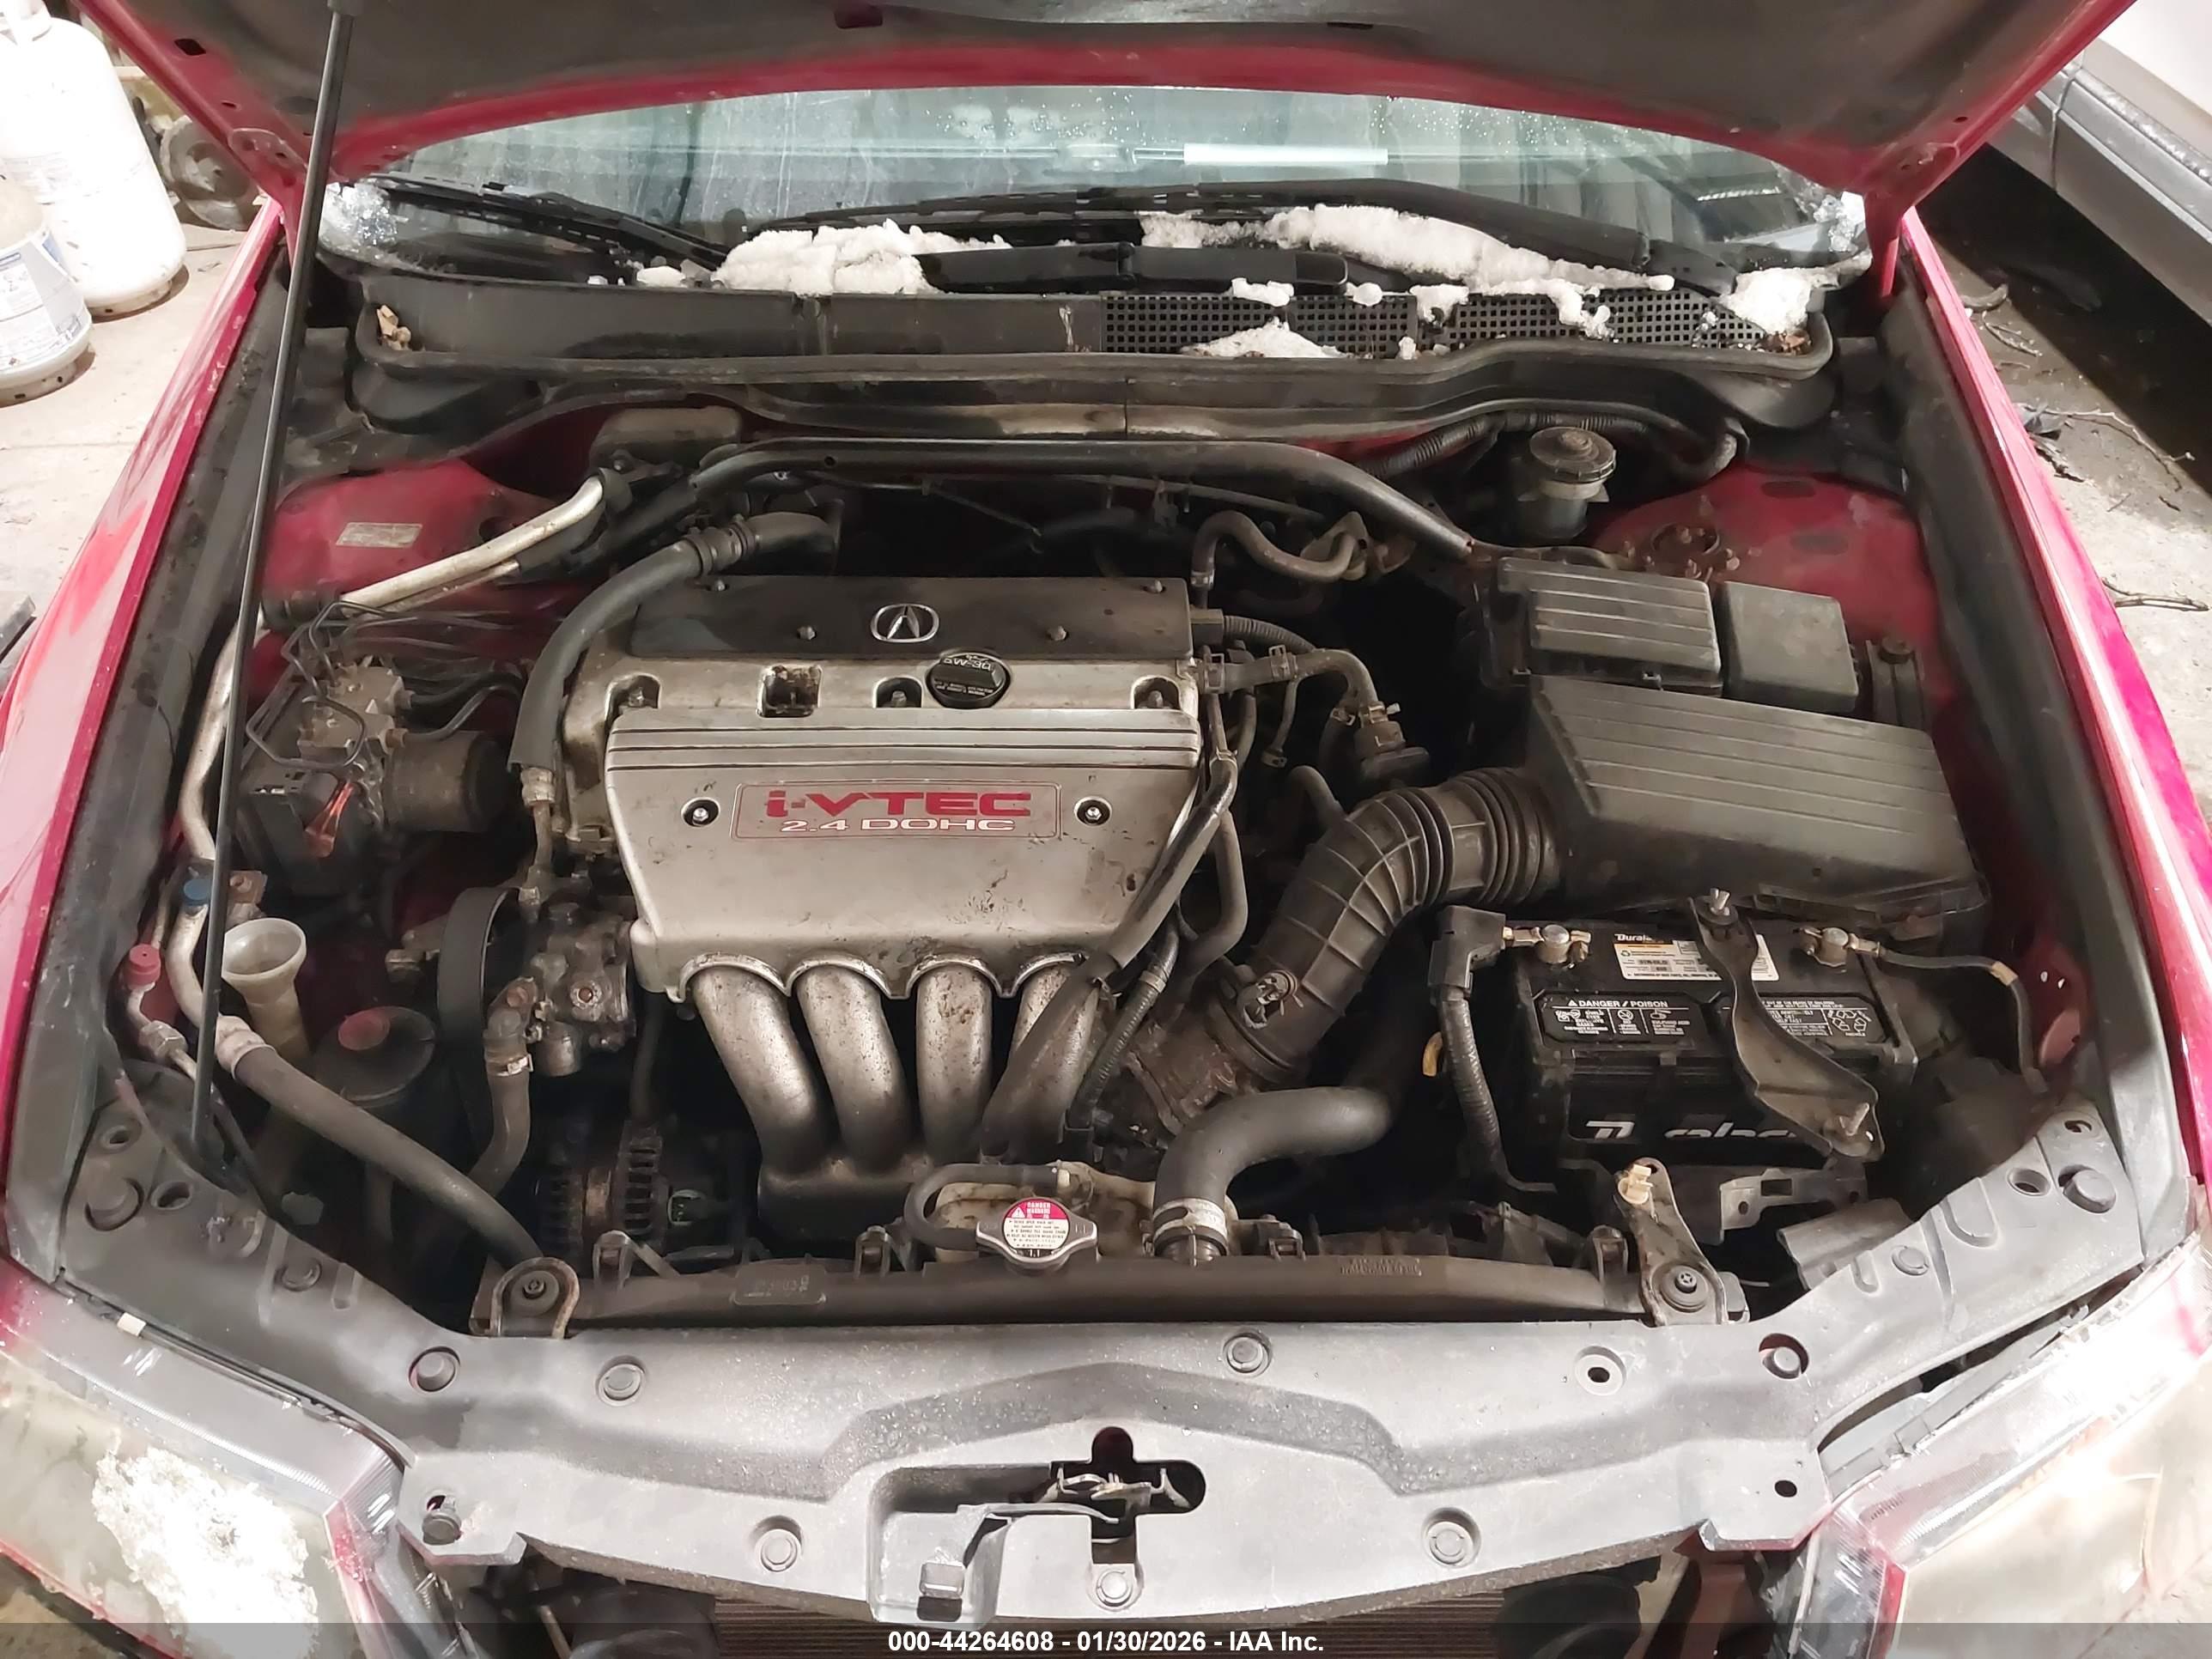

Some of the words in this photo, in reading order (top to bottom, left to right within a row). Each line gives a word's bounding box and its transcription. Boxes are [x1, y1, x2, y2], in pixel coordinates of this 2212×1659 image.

[765, 790, 1030, 817] i-VTEC
[781, 819, 848, 831] 2.4
[860, 818, 1014, 831] DOHC
